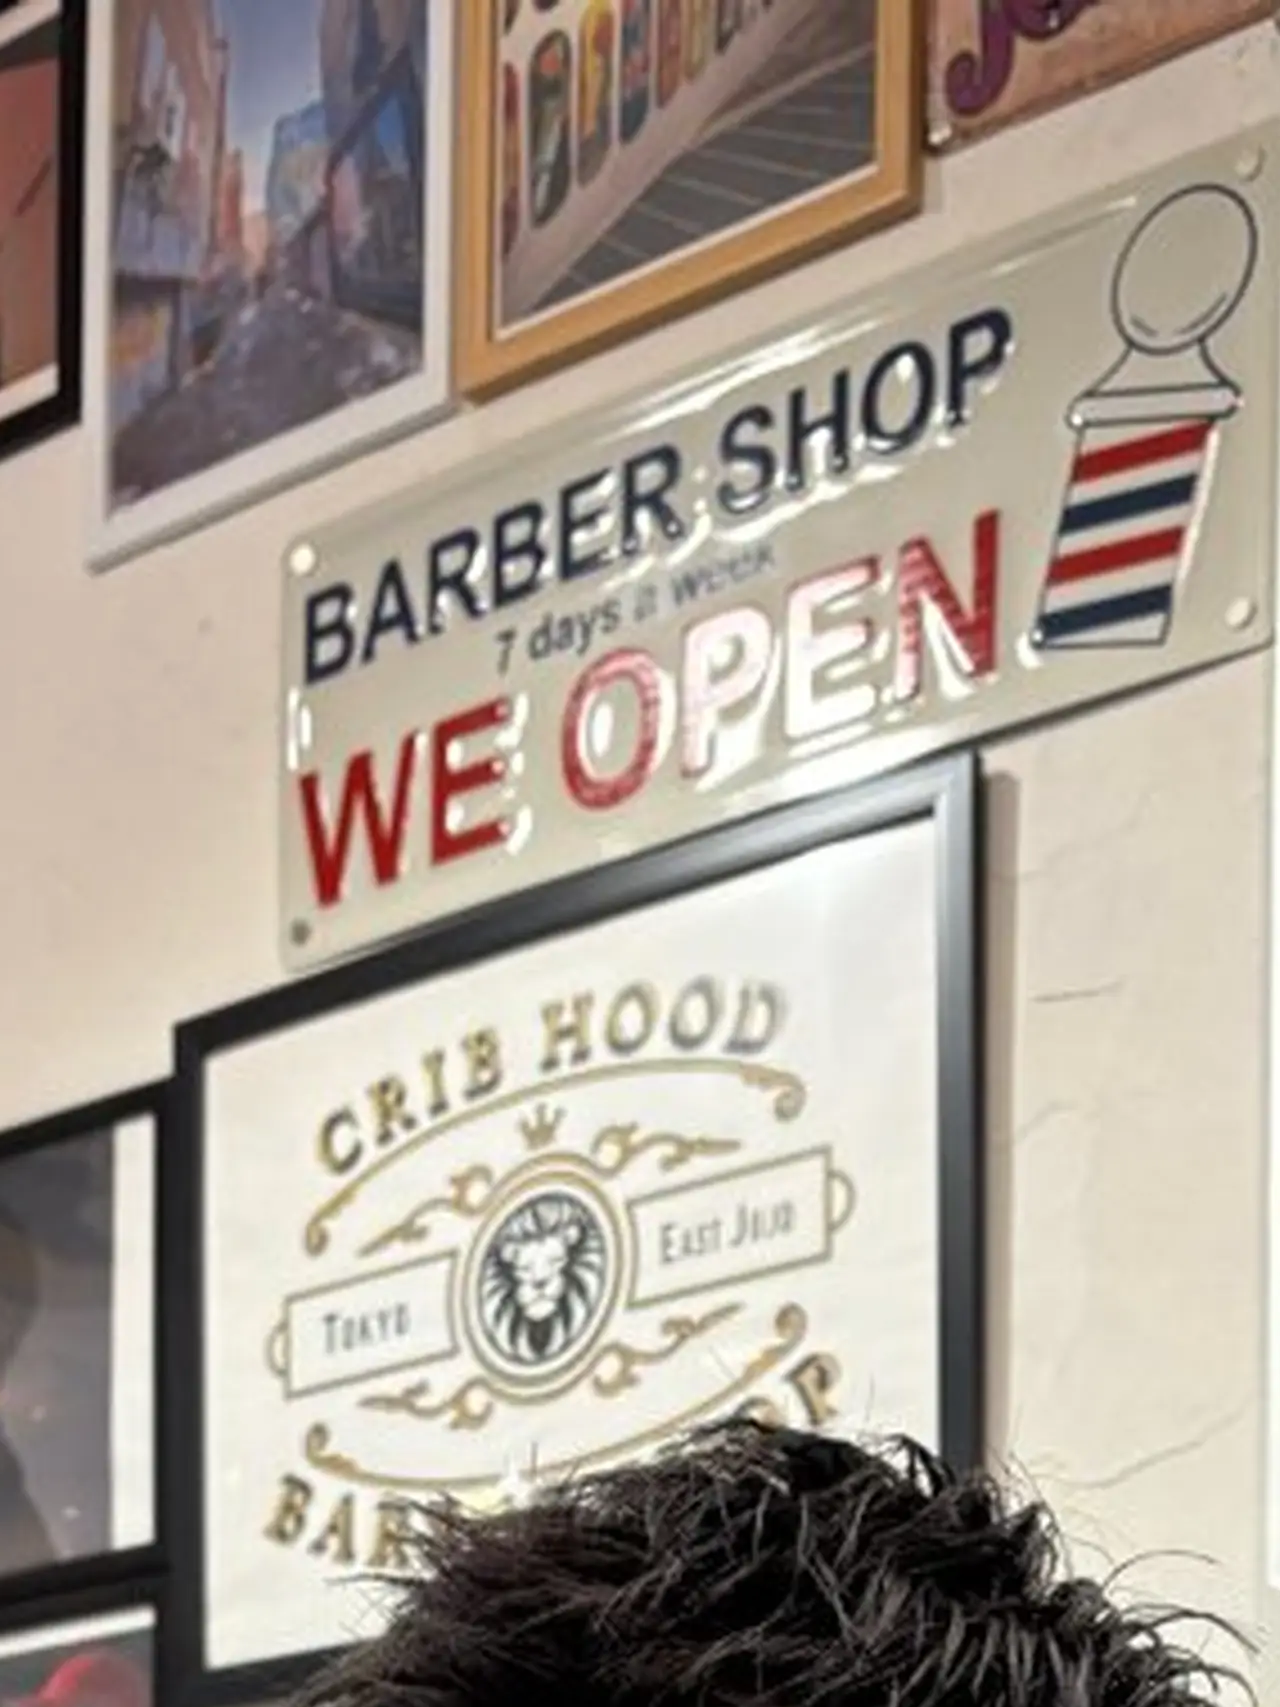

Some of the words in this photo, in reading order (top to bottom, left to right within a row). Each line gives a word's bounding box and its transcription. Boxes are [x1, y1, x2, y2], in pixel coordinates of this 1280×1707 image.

[303, 444, 685, 685] BARBER
[713, 306, 1014, 515] SHOP
[298, 694, 511, 907] WE
[560, 510, 1001, 811] OPEN
[495, 627, 517, 676] 7
[528, 597, 621, 661] days
[315, 1025, 502, 1177] CRIB
[538, 973, 790, 1070] HOOD
[263, 1473, 416, 1569] BAR
